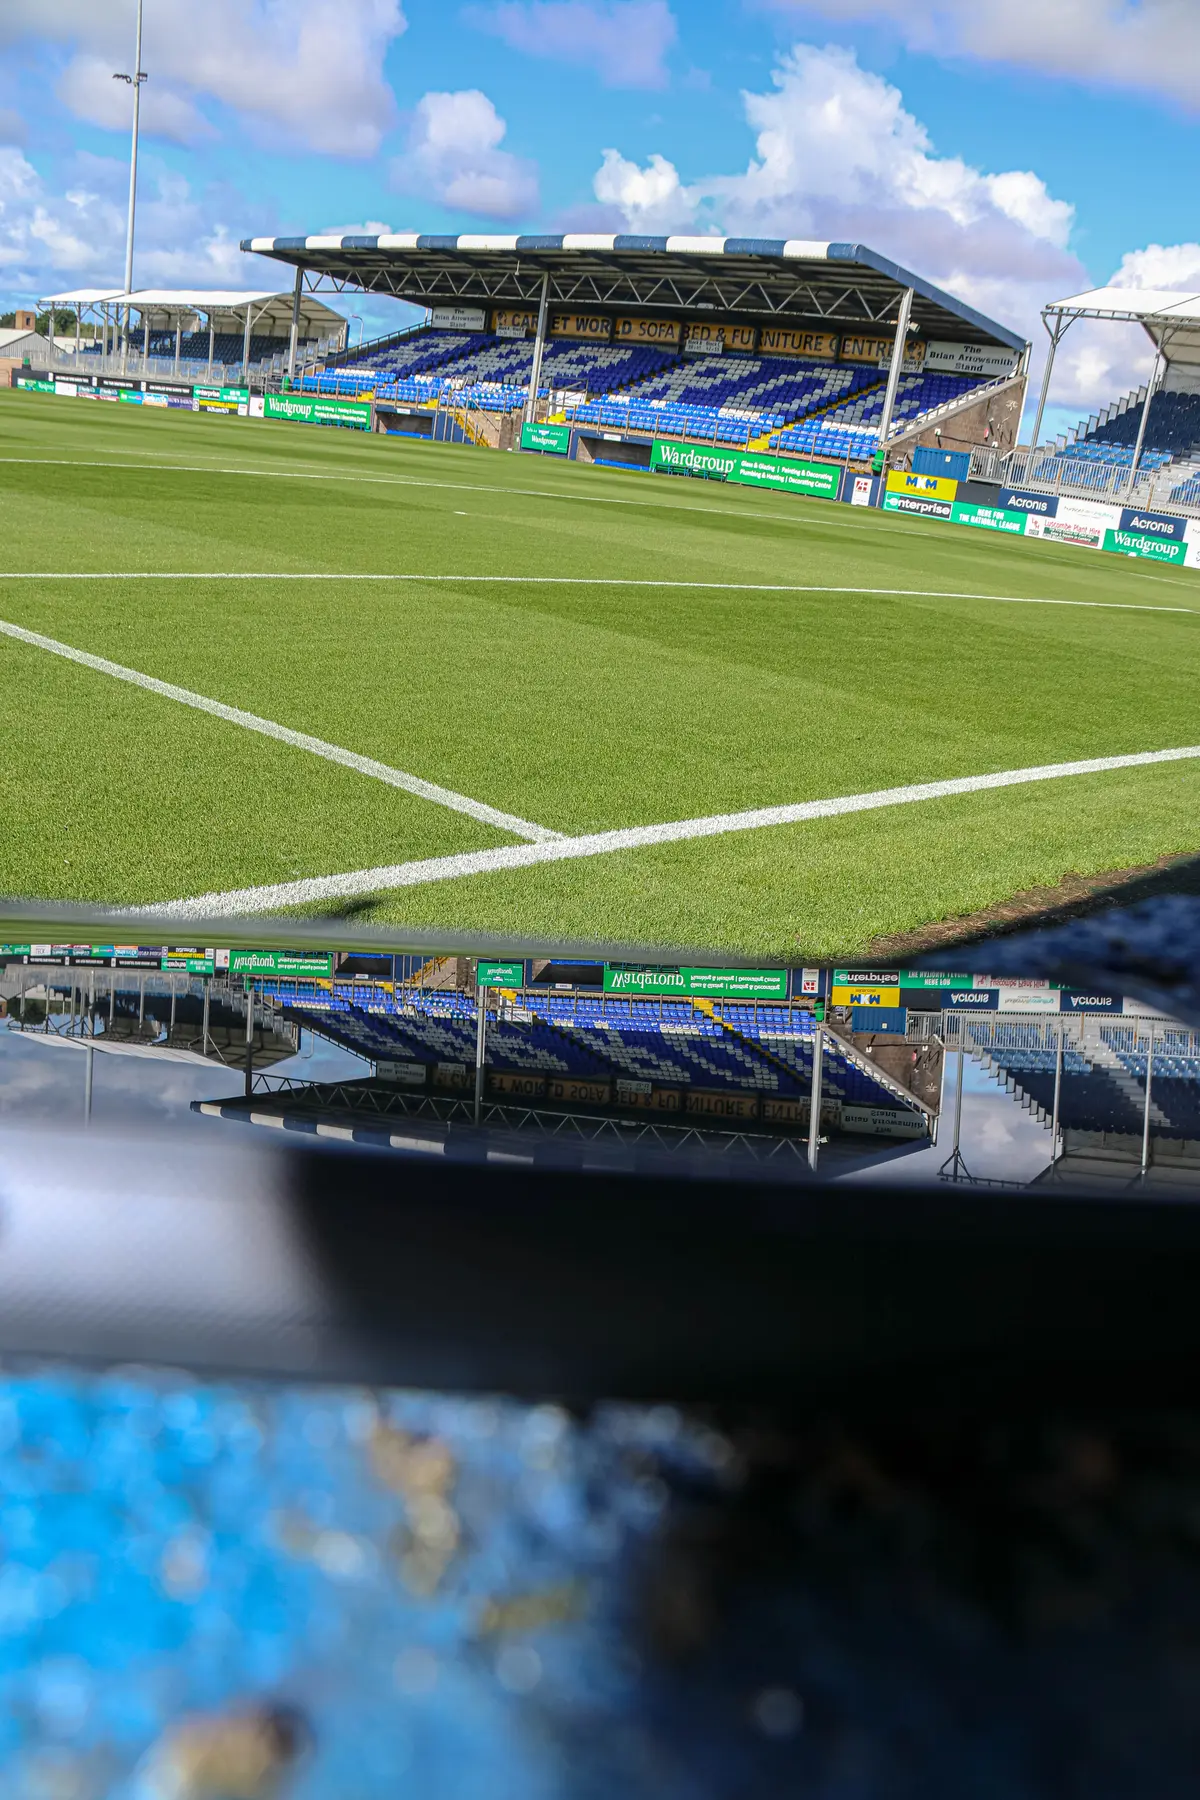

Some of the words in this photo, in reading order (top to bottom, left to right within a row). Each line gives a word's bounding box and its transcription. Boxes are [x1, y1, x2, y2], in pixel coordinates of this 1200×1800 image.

[511, 313, 570, 330] CARET
[638, 322, 675, 339] SOFA
[682, 325, 711, 341] BED
[715, 327, 727, 343] &
[731, 328, 823, 352] FUNITURE
[929, 351, 955, 360] Brian
[958, 353, 1013, 366] Arrowsmith
[963, 345, 982, 354] The
[955, 362, 984, 373] Stand
[268, 397, 311, 419] Wardgroup
[660, 445, 734, 473] Wardgroup
[739, 469, 762, 480] Plumbing
[788, 476, 814, 488] Decorating
[814, 480, 831, 490] Centre
[740, 460, 754, 468] Glass
[758, 463, 776, 473] Glazing
[781, 466, 801, 477] Painting
[806, 470, 833, 482] Decorating
[905, 475, 938, 490] MKM
[888, 497, 950, 515] enterprise
[1007, 495, 1048, 512] Acronis
[958, 513, 969, 522] THE
[970, 515, 998, 528] NATIONAL
[998, 520, 1021, 532] LEAGUE
[977, 508, 993, 518] HERE
[994, 511, 1005, 520] FOR
[1073, 523, 1088, 533] Plant
[1129, 516, 1175, 534] Acronis
[1114, 531, 1179, 558] Wardgroup
